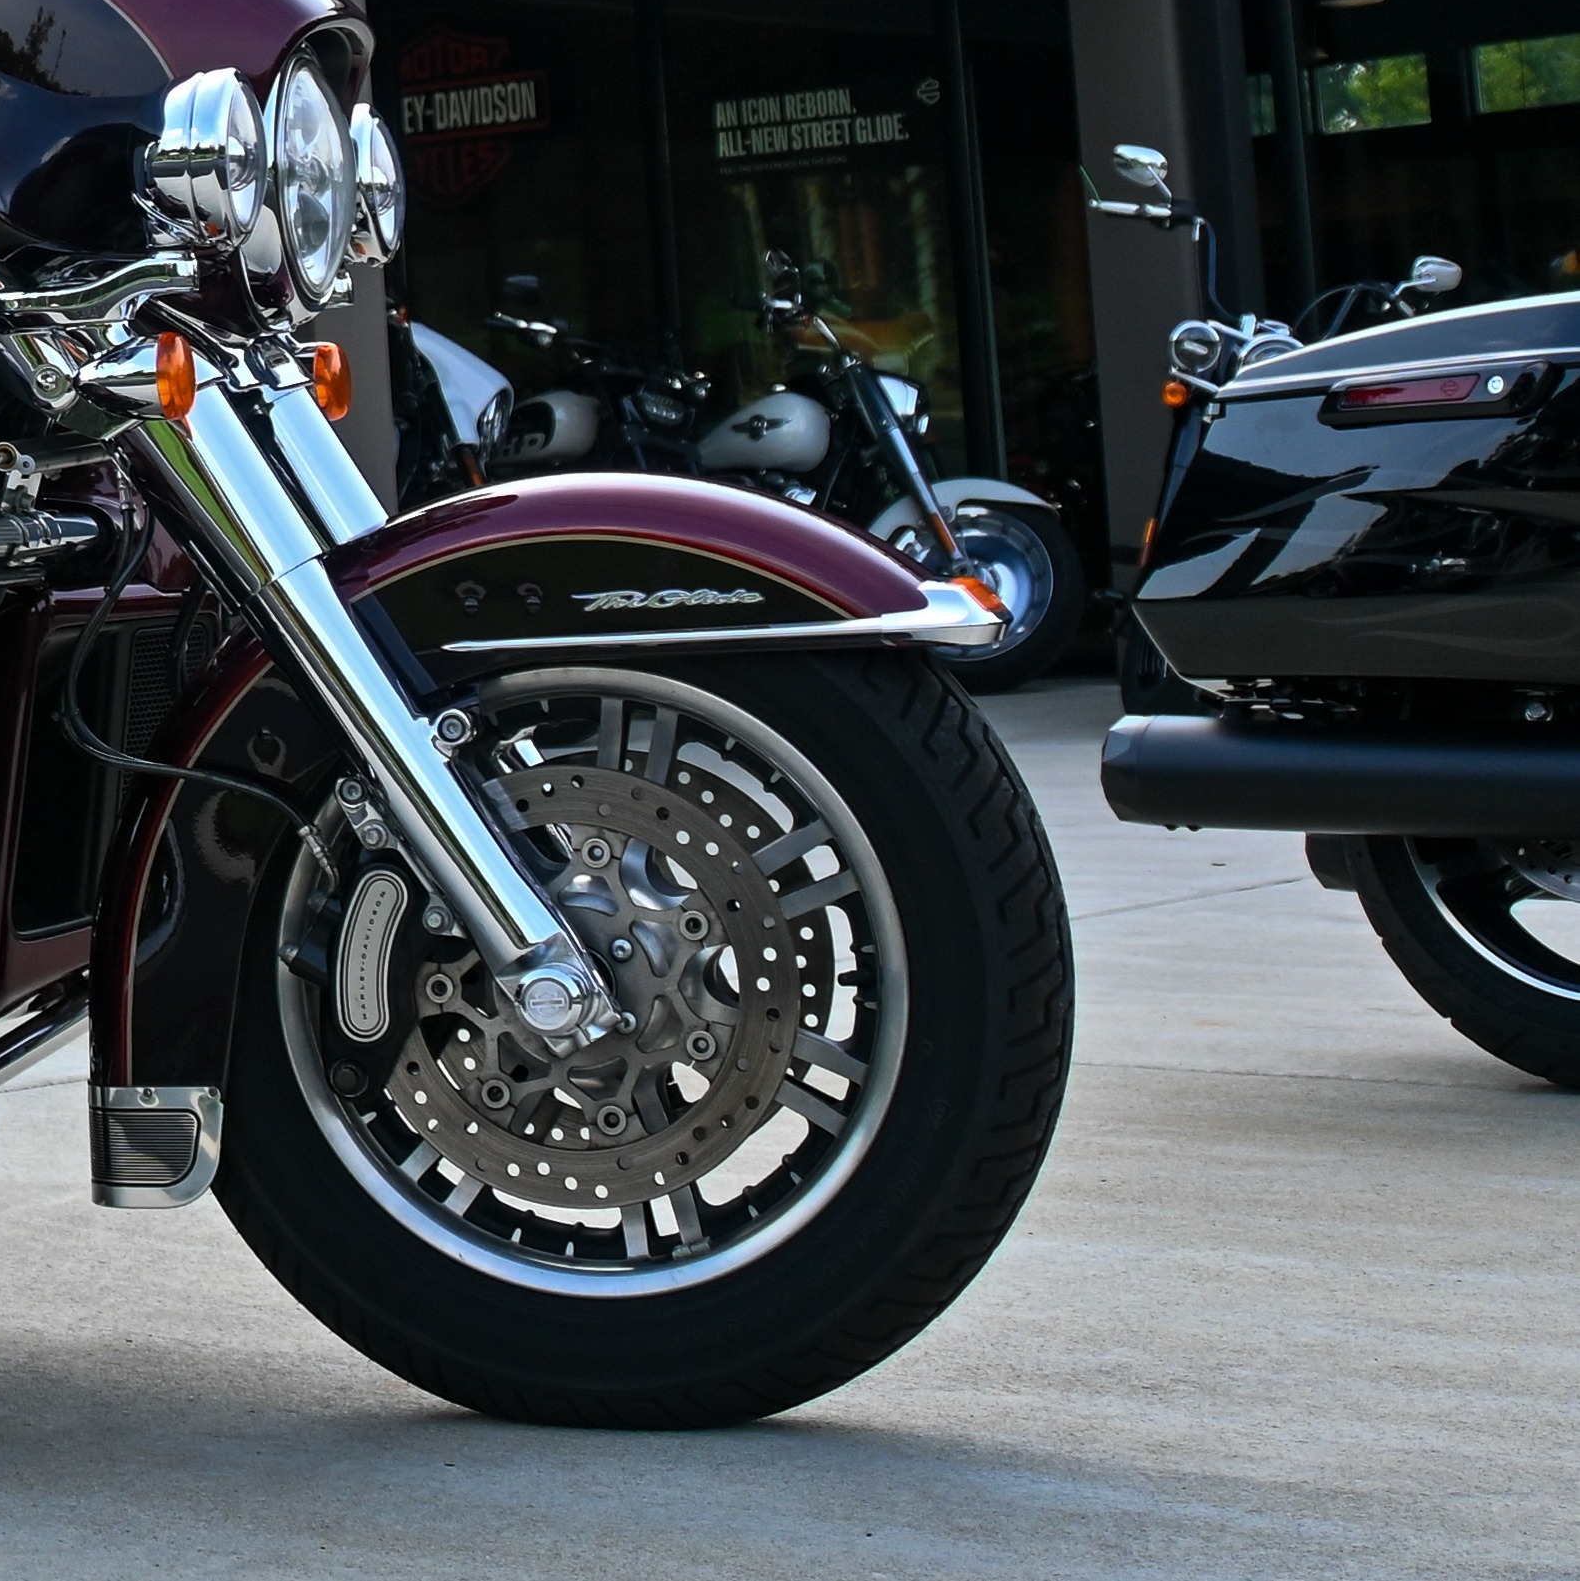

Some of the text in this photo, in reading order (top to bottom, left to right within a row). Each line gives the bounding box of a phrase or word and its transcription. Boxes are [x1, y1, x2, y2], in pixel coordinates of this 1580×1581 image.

[402, 79, 538, 135] EY-DAVIDSON
[715, 87, 857, 129] AN ICON REBORN.
[718, 113, 910, 158] ALL-NEW STREET GLIDE.
